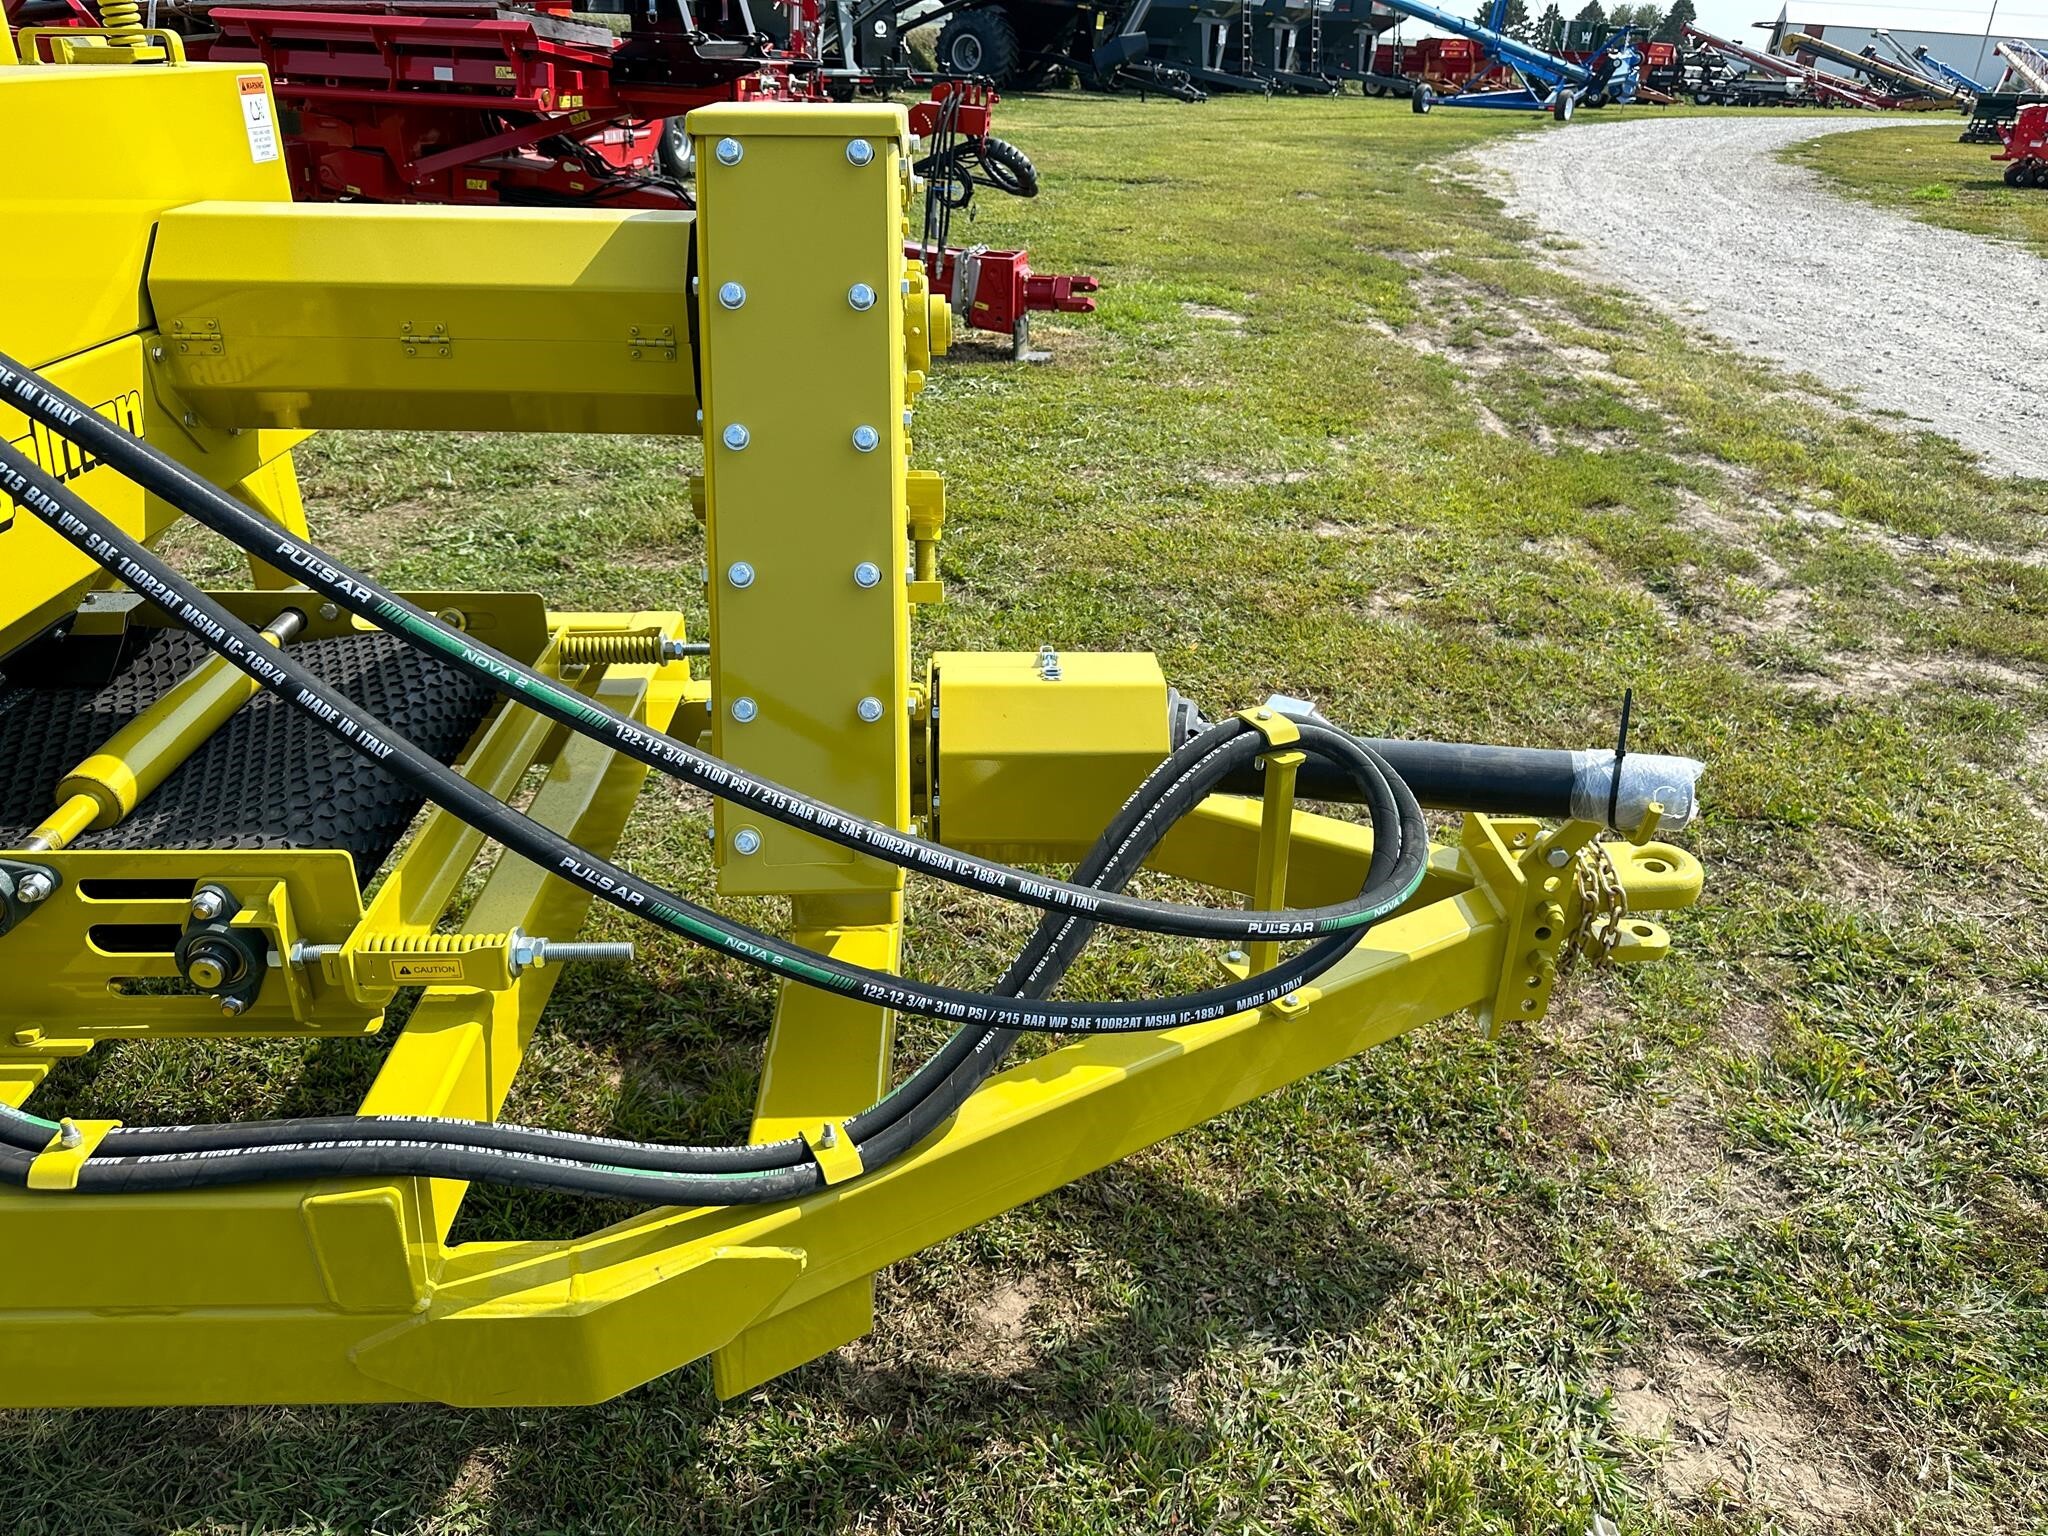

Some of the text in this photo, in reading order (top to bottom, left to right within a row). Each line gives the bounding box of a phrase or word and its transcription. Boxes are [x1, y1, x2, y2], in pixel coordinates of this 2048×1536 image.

[0, 364, 17, 387] DE
[14, 379, 39, 401] IN
[37, 393, 82, 427] ITALY
[24, 486, 60, 517] BAR
[58, 511, 88, 536] WP
[85, 533, 119, 562] SAE
[117, 556, 183, 609] 100R2AT
[179, 603, 226, 642] MSHA
[223, 635, 287, 686] IC-188/4
[296, 687, 343, 724] MADE
[336, 712, 361, 738] IN
[355, 729, 394, 760] ITALY
[276, 542, 529, 688] PULSAR NOVA 2
[615, 724, 1100, 912] 122-12 3/4" 3100 PSI / 215 BAR WP SAE 100R2AT MSHA IC-188/4 MADE IN ITALY
[559, 857, 784, 966] PULSAR NOVA 2
[1248, 921, 1314, 934] PULSAR
[1374, 899, 1400, 917] NOVA
[862, 975, 1303, 1030] 122-12 3/4" 3100 PSI / 215 BAR WP SAE 100R2AT MSHA IC-188/4 MADE IN ITALY
